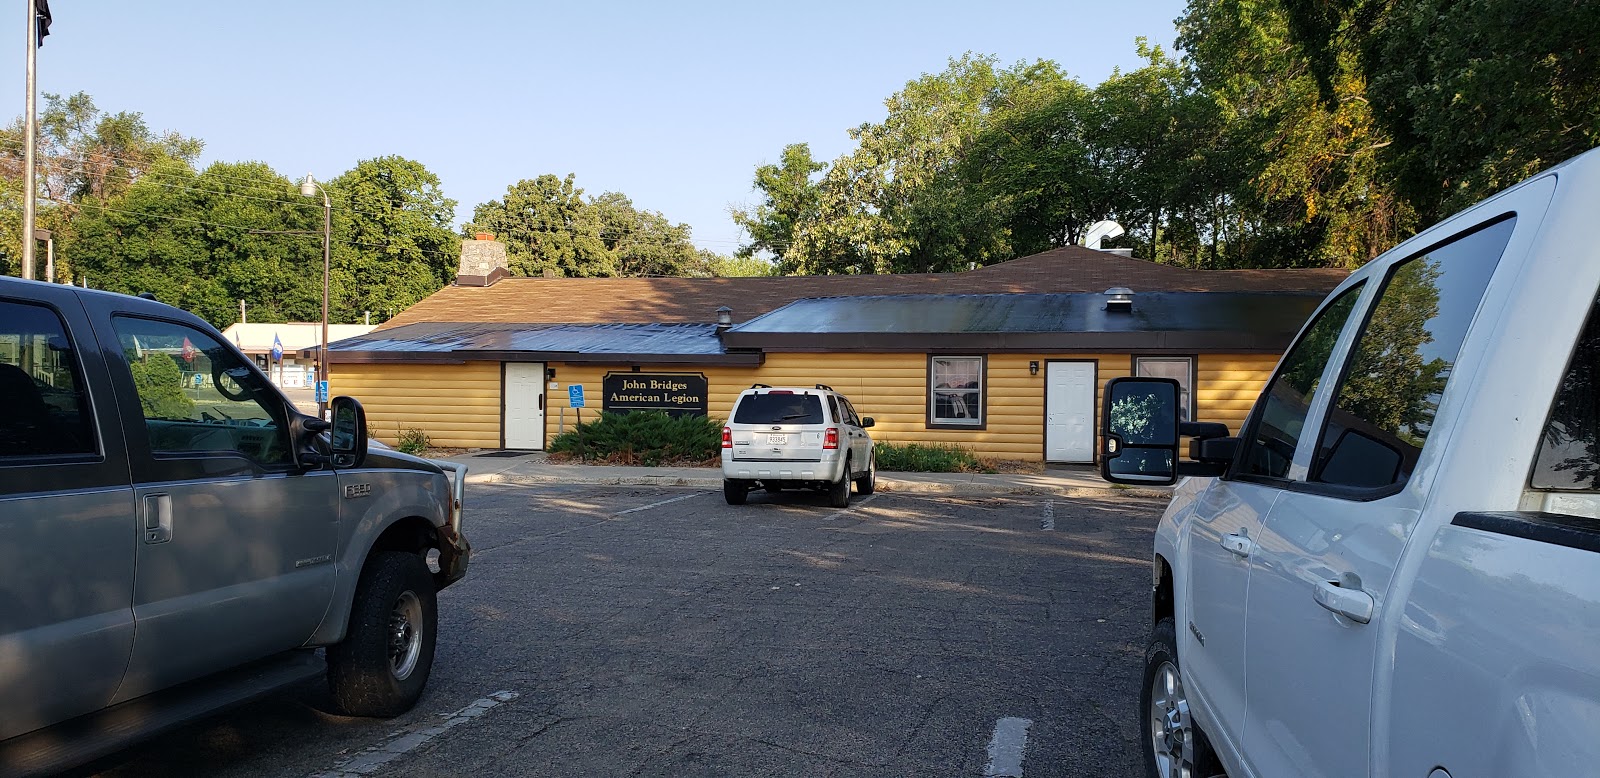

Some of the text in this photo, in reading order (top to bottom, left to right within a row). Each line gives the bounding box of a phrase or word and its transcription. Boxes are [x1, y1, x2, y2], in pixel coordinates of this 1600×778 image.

[622, 379, 687, 391] John Bridges
[610, 392, 699, 405] American Legion
